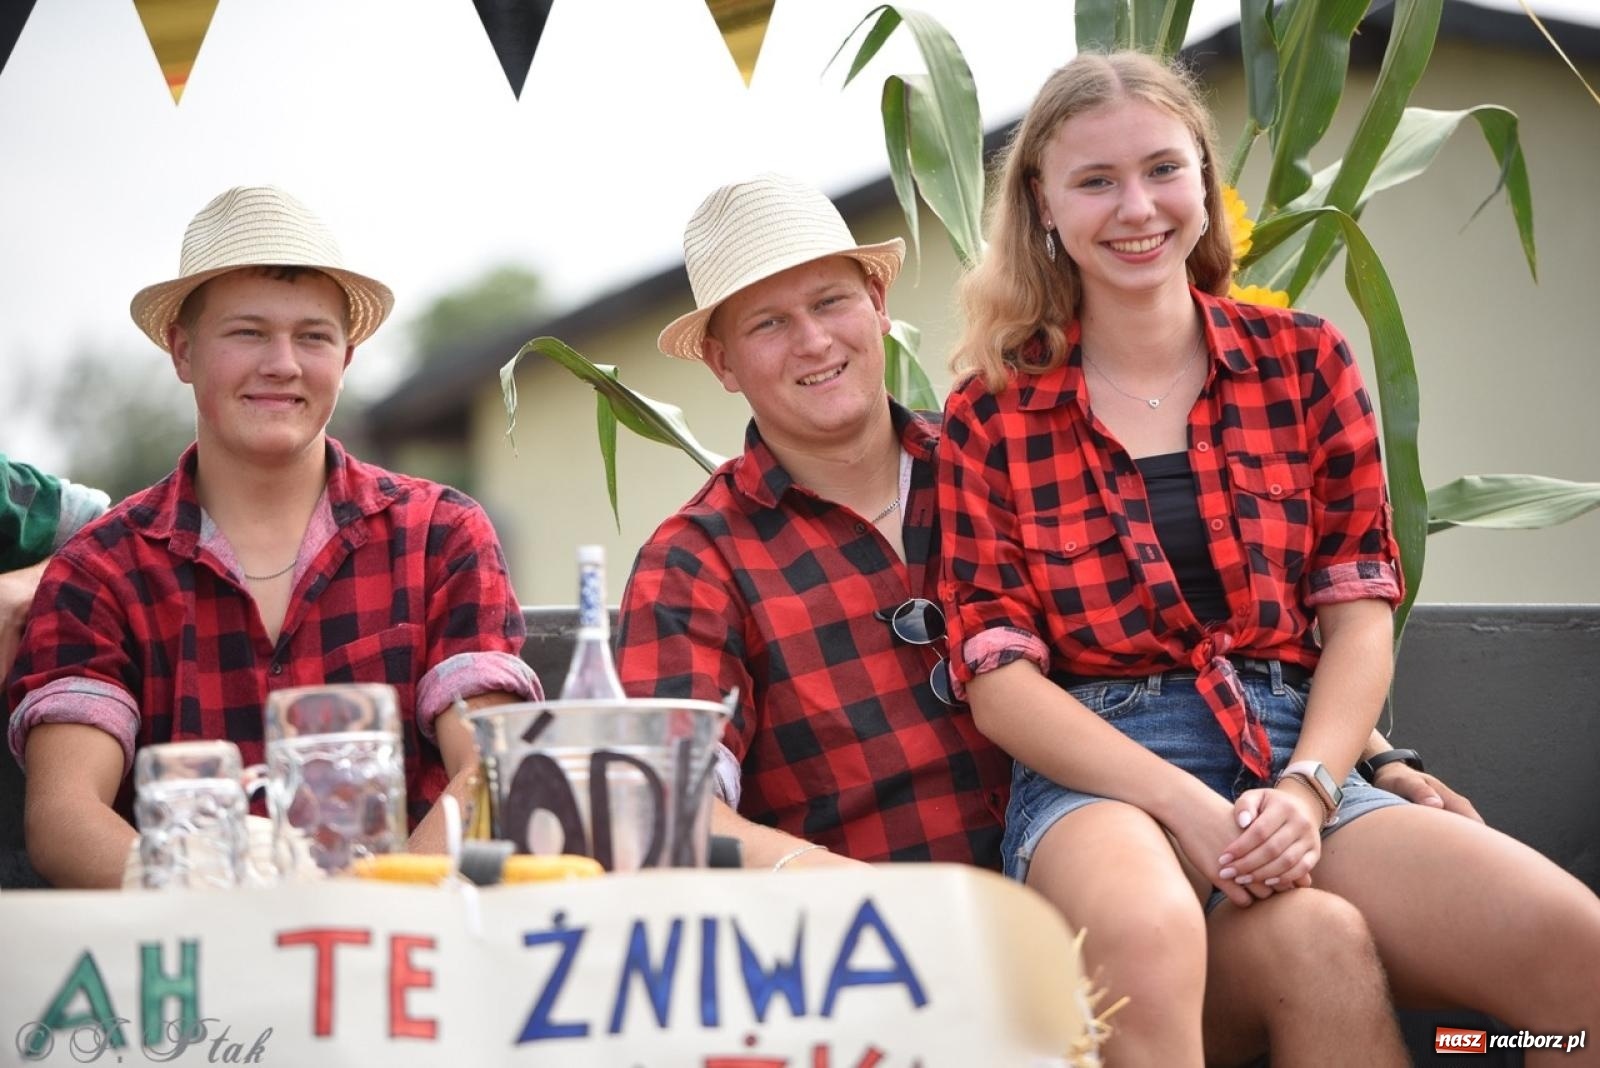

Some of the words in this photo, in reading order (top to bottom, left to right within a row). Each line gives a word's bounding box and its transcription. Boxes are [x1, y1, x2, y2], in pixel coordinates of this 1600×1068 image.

[22, 937, 203, 1057] AH
[275, 926, 439, 1041] TE
[513, 896, 931, 1045] ŻNIWA
